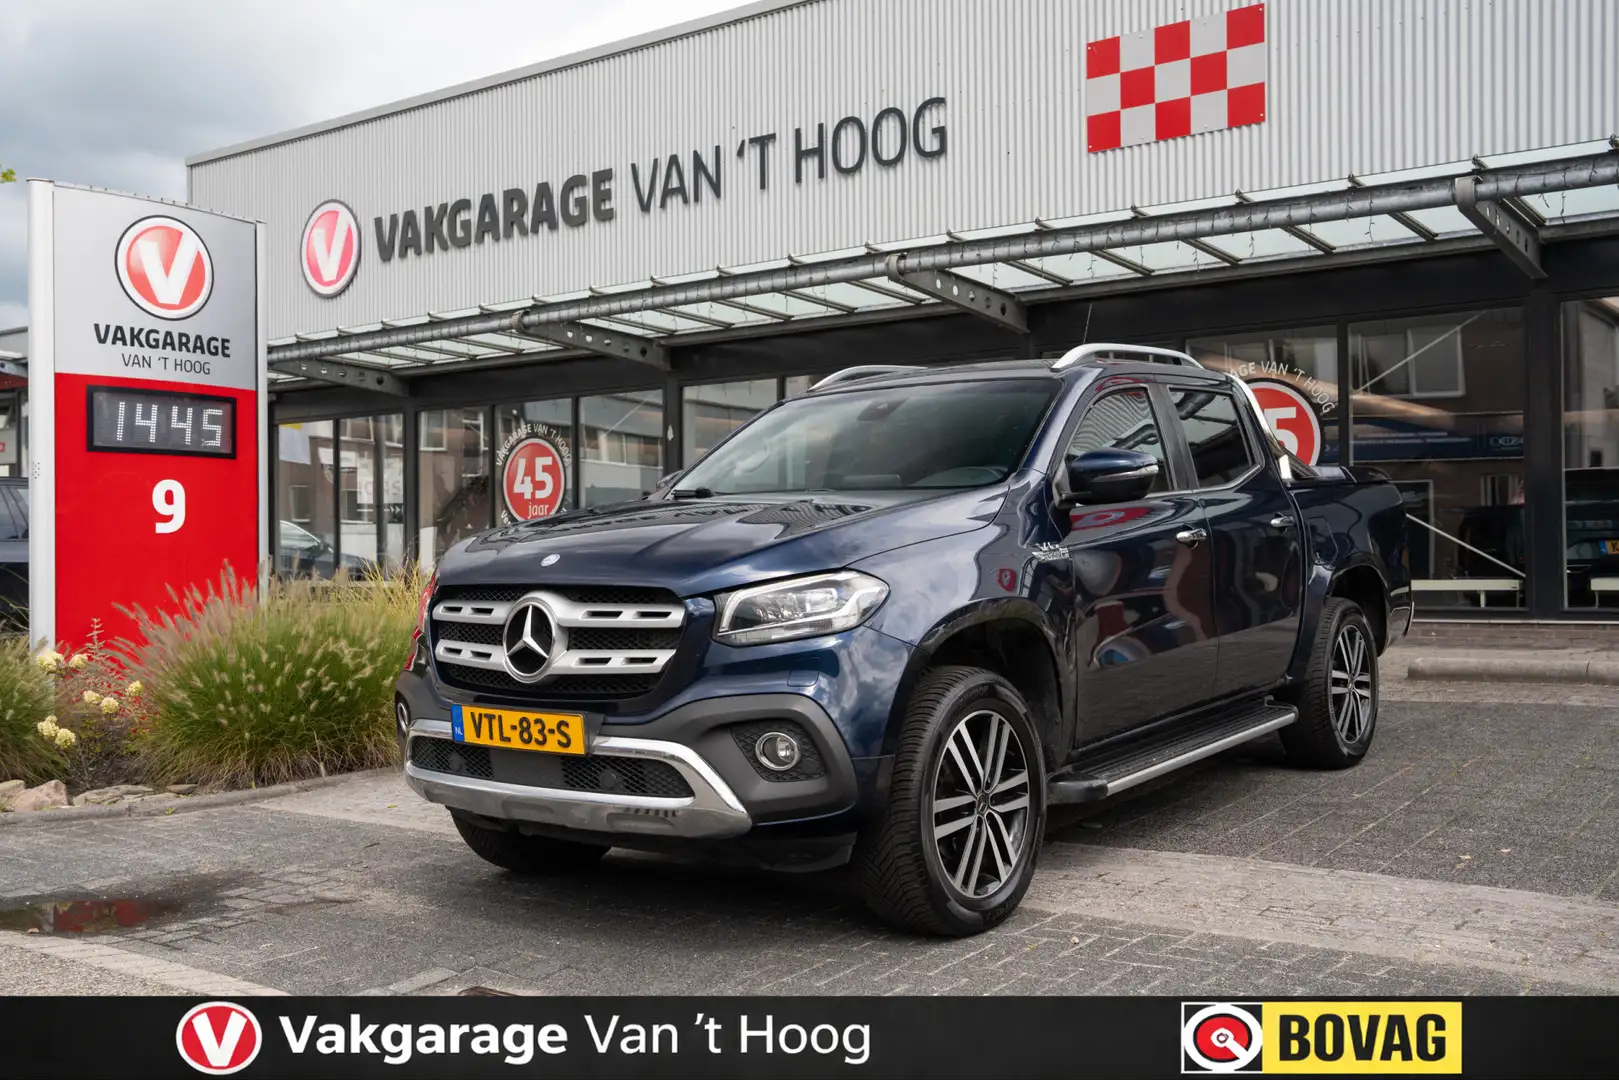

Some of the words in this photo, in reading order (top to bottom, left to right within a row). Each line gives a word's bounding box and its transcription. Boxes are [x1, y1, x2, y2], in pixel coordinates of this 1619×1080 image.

[374, 168, 614, 262] VAKGARAGE
[631, 145, 722, 213] VAN
[736, 132, 776, 190] 'T
[795, 97, 947, 184] HOOG
[139, 230, 200, 305] V
[94, 323, 231, 358] VAKGARAGE
[121, 353, 152, 369] VAN
[174, 358, 211, 375] HOOG
[1260, 361, 1289, 375] VAN
[1304, 377, 1336, 414] HOOG
[496, 423, 532, 466] VAKGARAGE
[533, 423, 549, 435] VAN
[555, 435, 572, 465] HOOG
[513, 456, 554, 500] 45
[151, 478, 186, 534] 9
[527, 502, 549, 519] jaar
[454, 726, 463, 736] NL
[470, 711, 572, 748] VTL-83-S
